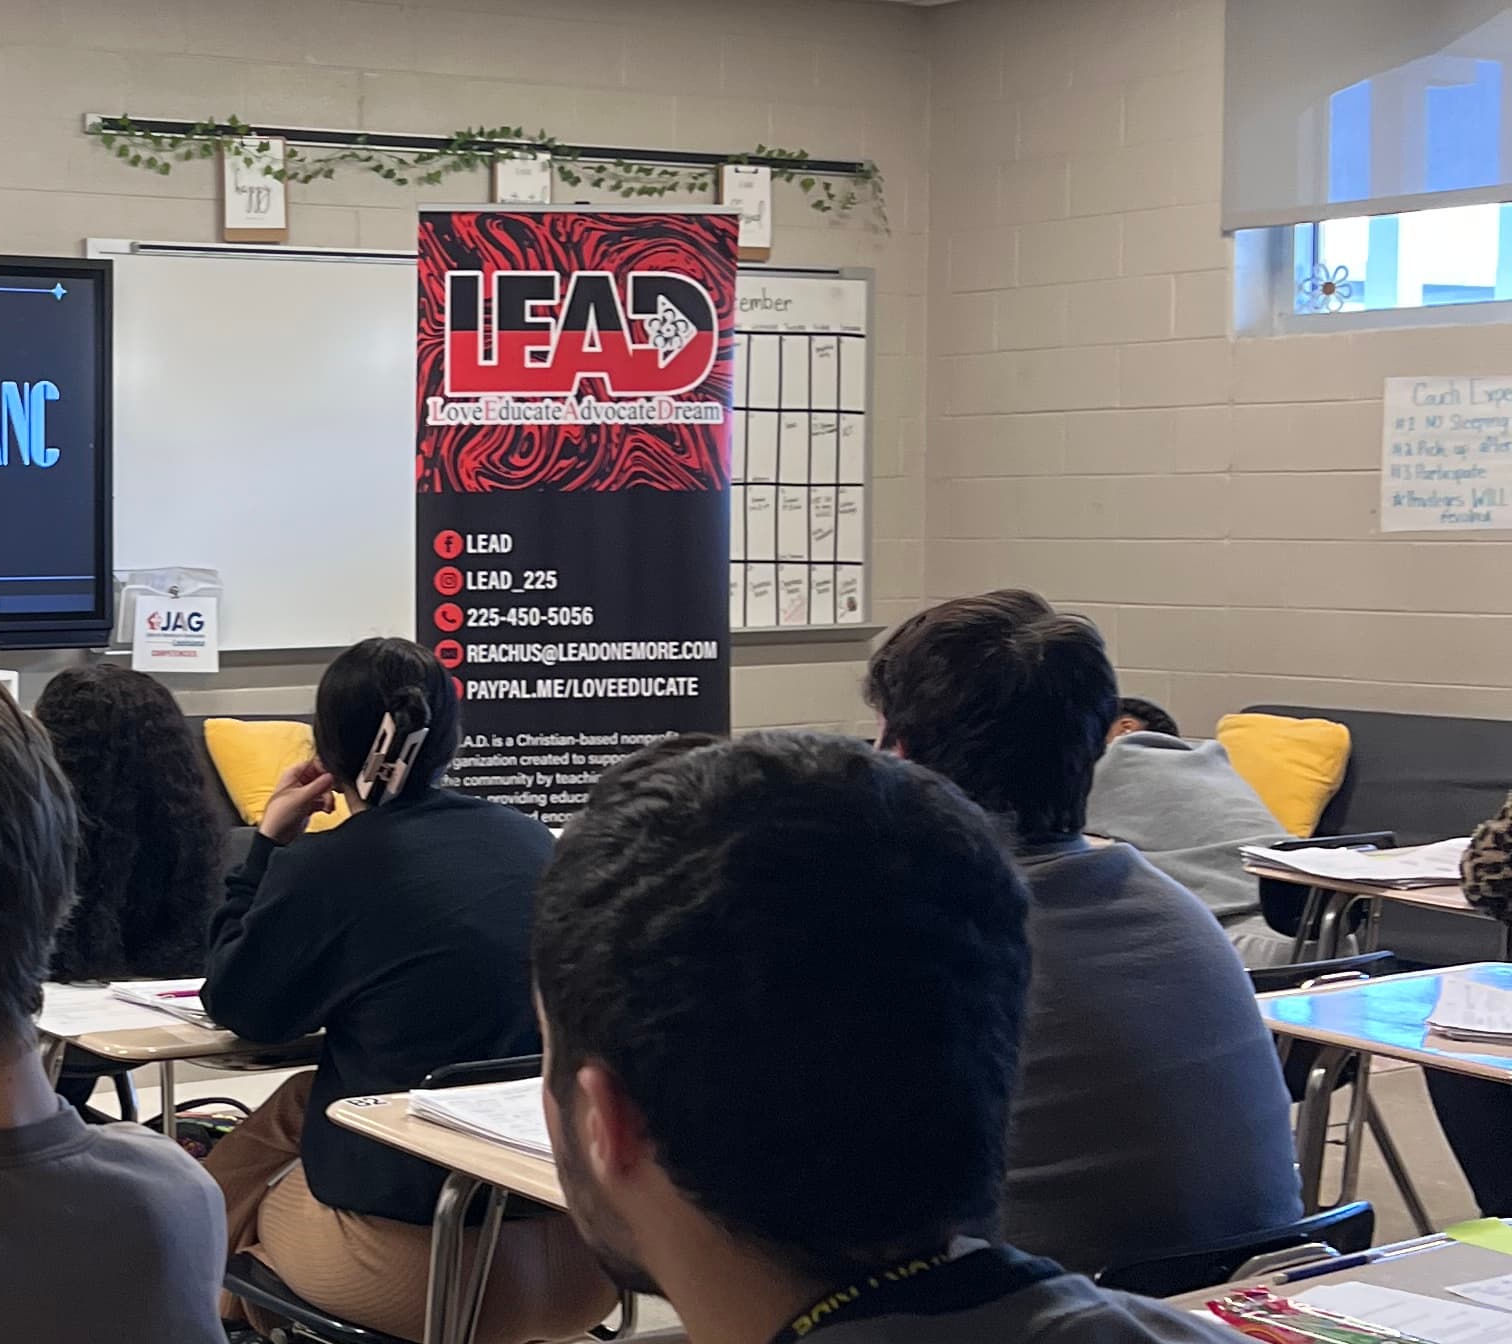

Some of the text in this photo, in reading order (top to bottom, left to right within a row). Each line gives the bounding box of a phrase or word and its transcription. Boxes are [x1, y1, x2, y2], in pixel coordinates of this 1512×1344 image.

[739, 287, 793, 313] ember
[445, 270, 719, 398] LEAD
[466, 533, 513, 555] LEAD
[466, 570, 558, 594] LEAD_225
[160, 611, 205, 633] JAG
[466, 606, 595, 628] 225-450-5056
[466, 640, 719, 666] REACHUS@LEADONEMORE.COM
[466, 676, 700, 700] PAYPAL.ME/LOVEEDUCATE
[491, 733, 504, 747] is
[505, 736, 515, 747] a
[516, 732, 618, 747] Christian-based
[452, 753, 518, 771] ganization
[519, 752, 570, 766] created
[571, 753, 586, 765] to
[463, 772, 534, 788] community
[535, 771, 554, 788] by
